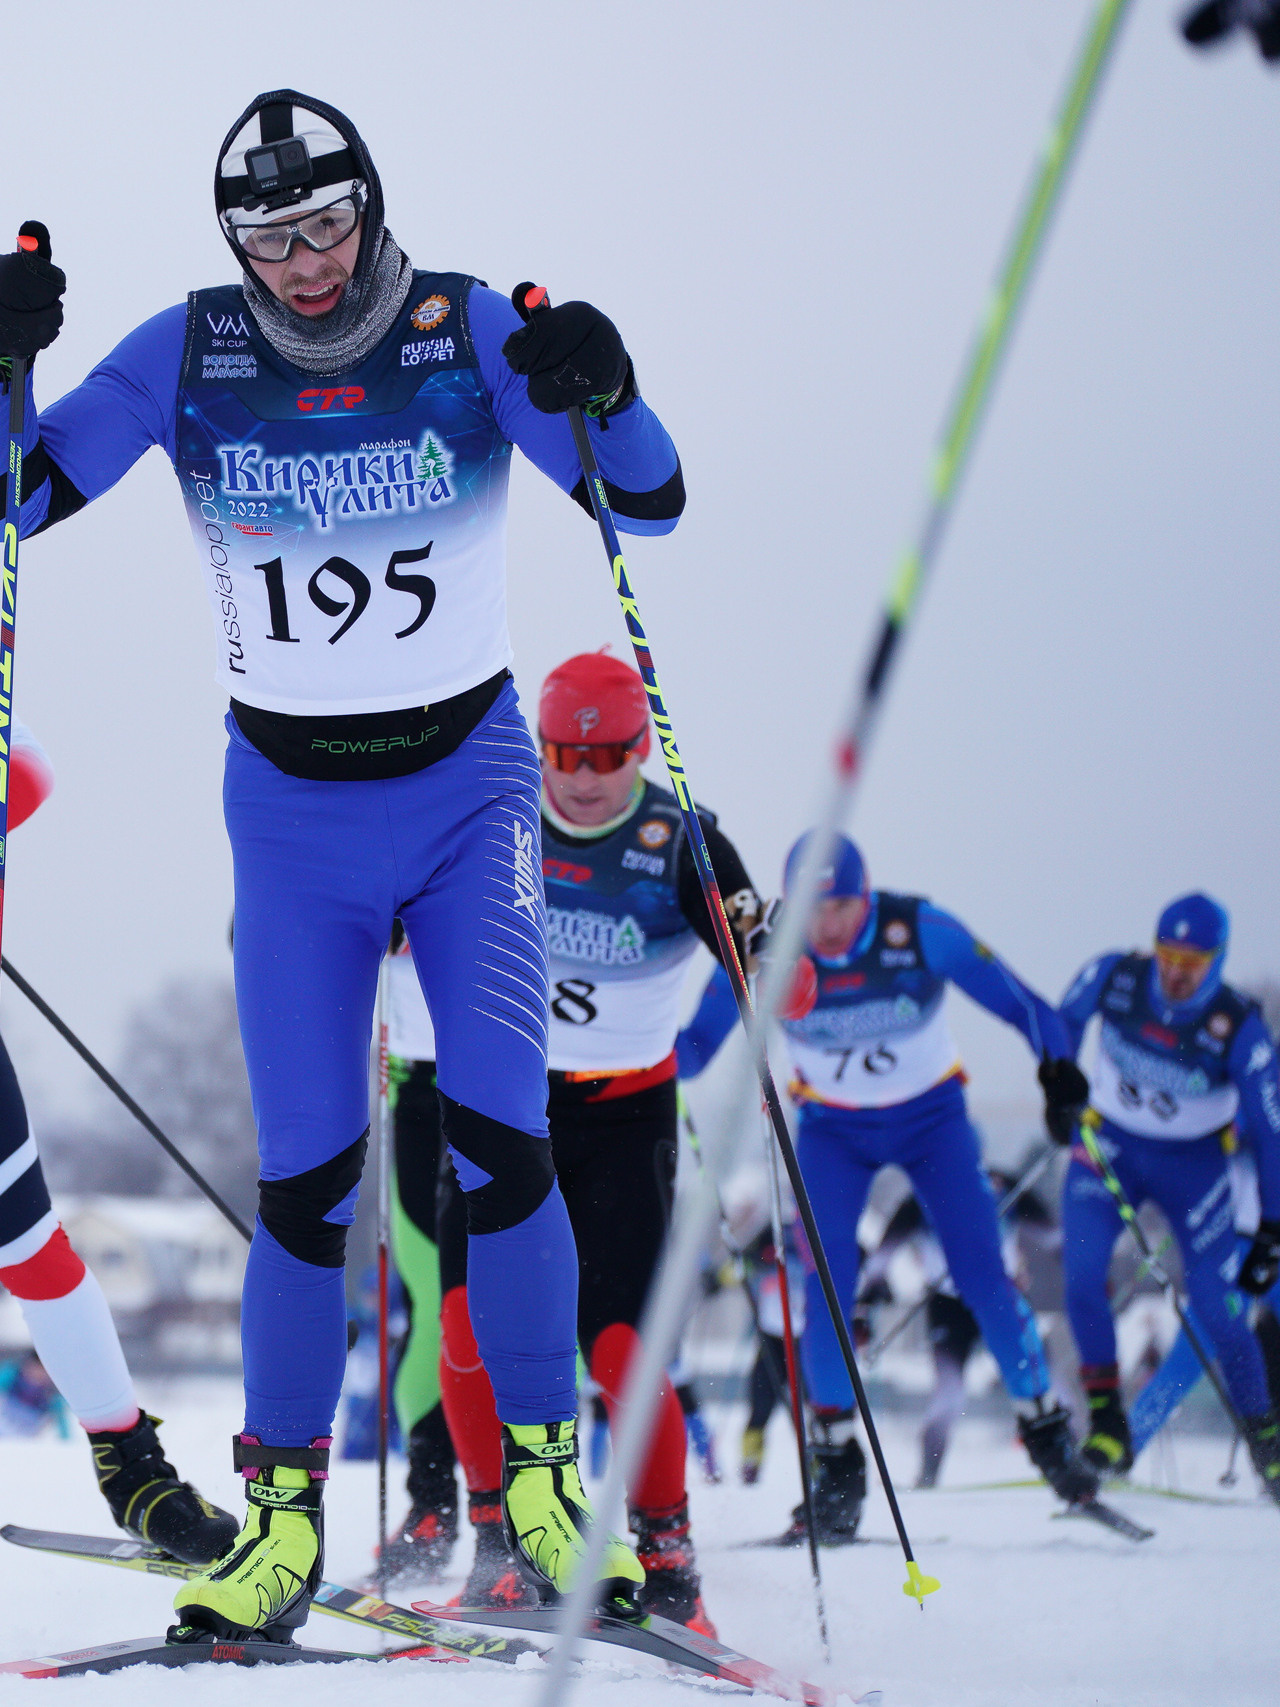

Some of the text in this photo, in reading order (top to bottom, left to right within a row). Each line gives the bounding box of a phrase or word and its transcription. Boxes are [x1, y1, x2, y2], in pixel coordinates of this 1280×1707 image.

[211, 339, 248, 348] SKI CUP
[401, 337, 455, 356] RUSSIA
[202, 354, 258, 367] ВОЛОГДА
[401, 349, 455, 367] LOPPET
[201, 363, 258, 379] МАРАФОН
[358, 438, 411, 452] марафон
[593, 477, 608, 509] DESIGN
[227, 500, 270, 518] 2022
[190, 469, 247, 675] russialoppet
[253, 540, 437, 646] 195
[311, 725, 440, 754] POWERUP
[541, 1442, 573, 1455] OW
[253, 1487, 288, 1499] OW
[211, 1645, 245, 1660] ATOMIC
